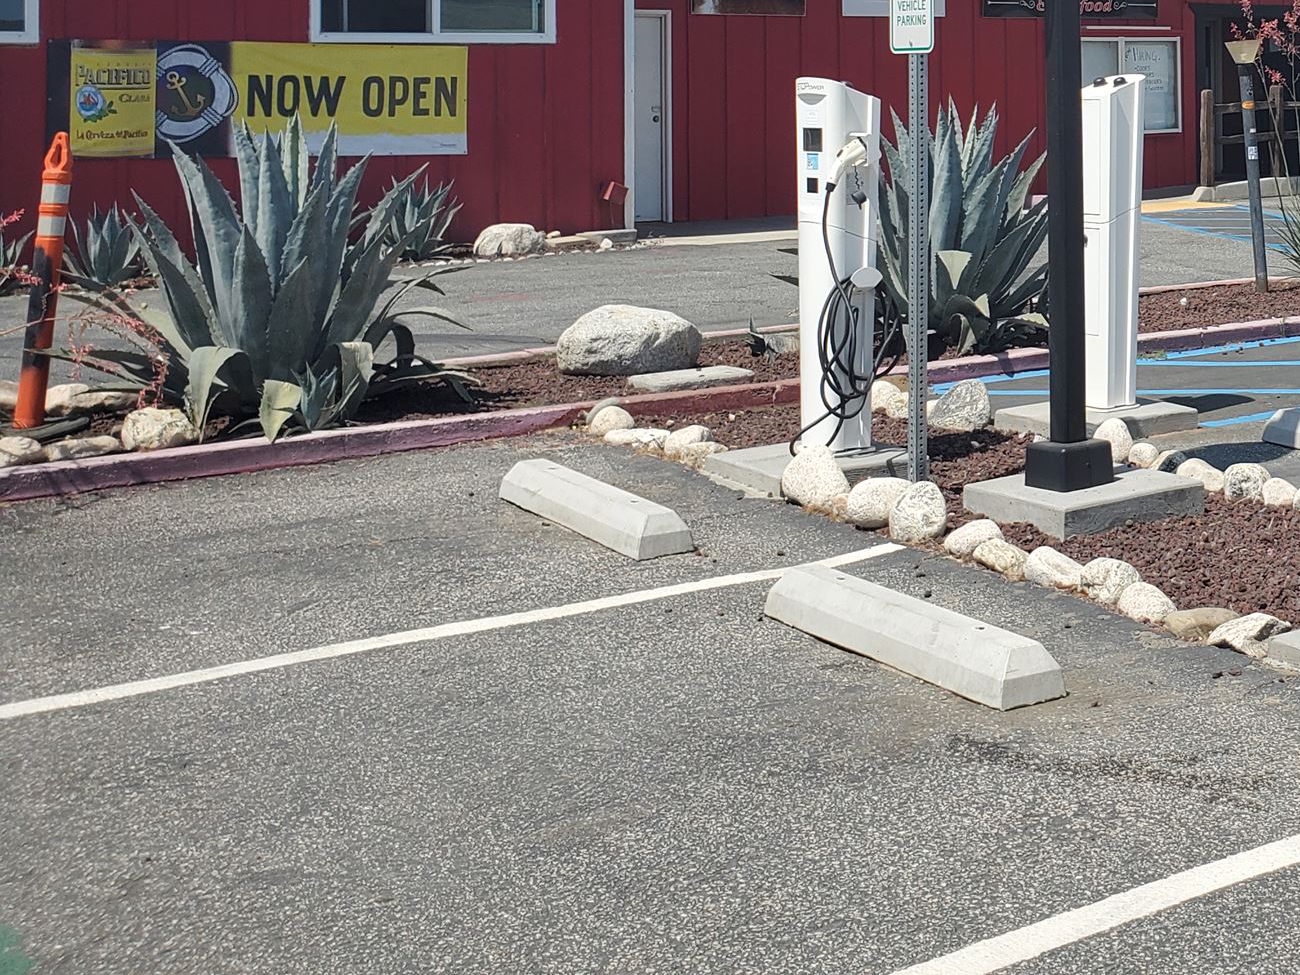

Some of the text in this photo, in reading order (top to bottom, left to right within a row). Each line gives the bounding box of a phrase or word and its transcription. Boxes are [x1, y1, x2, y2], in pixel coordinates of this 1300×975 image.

[897, 0, 927, 12] VEHICLE
[896, 14, 927, 26] PARKING
[246, 74, 458, 117] NOW OPEN
